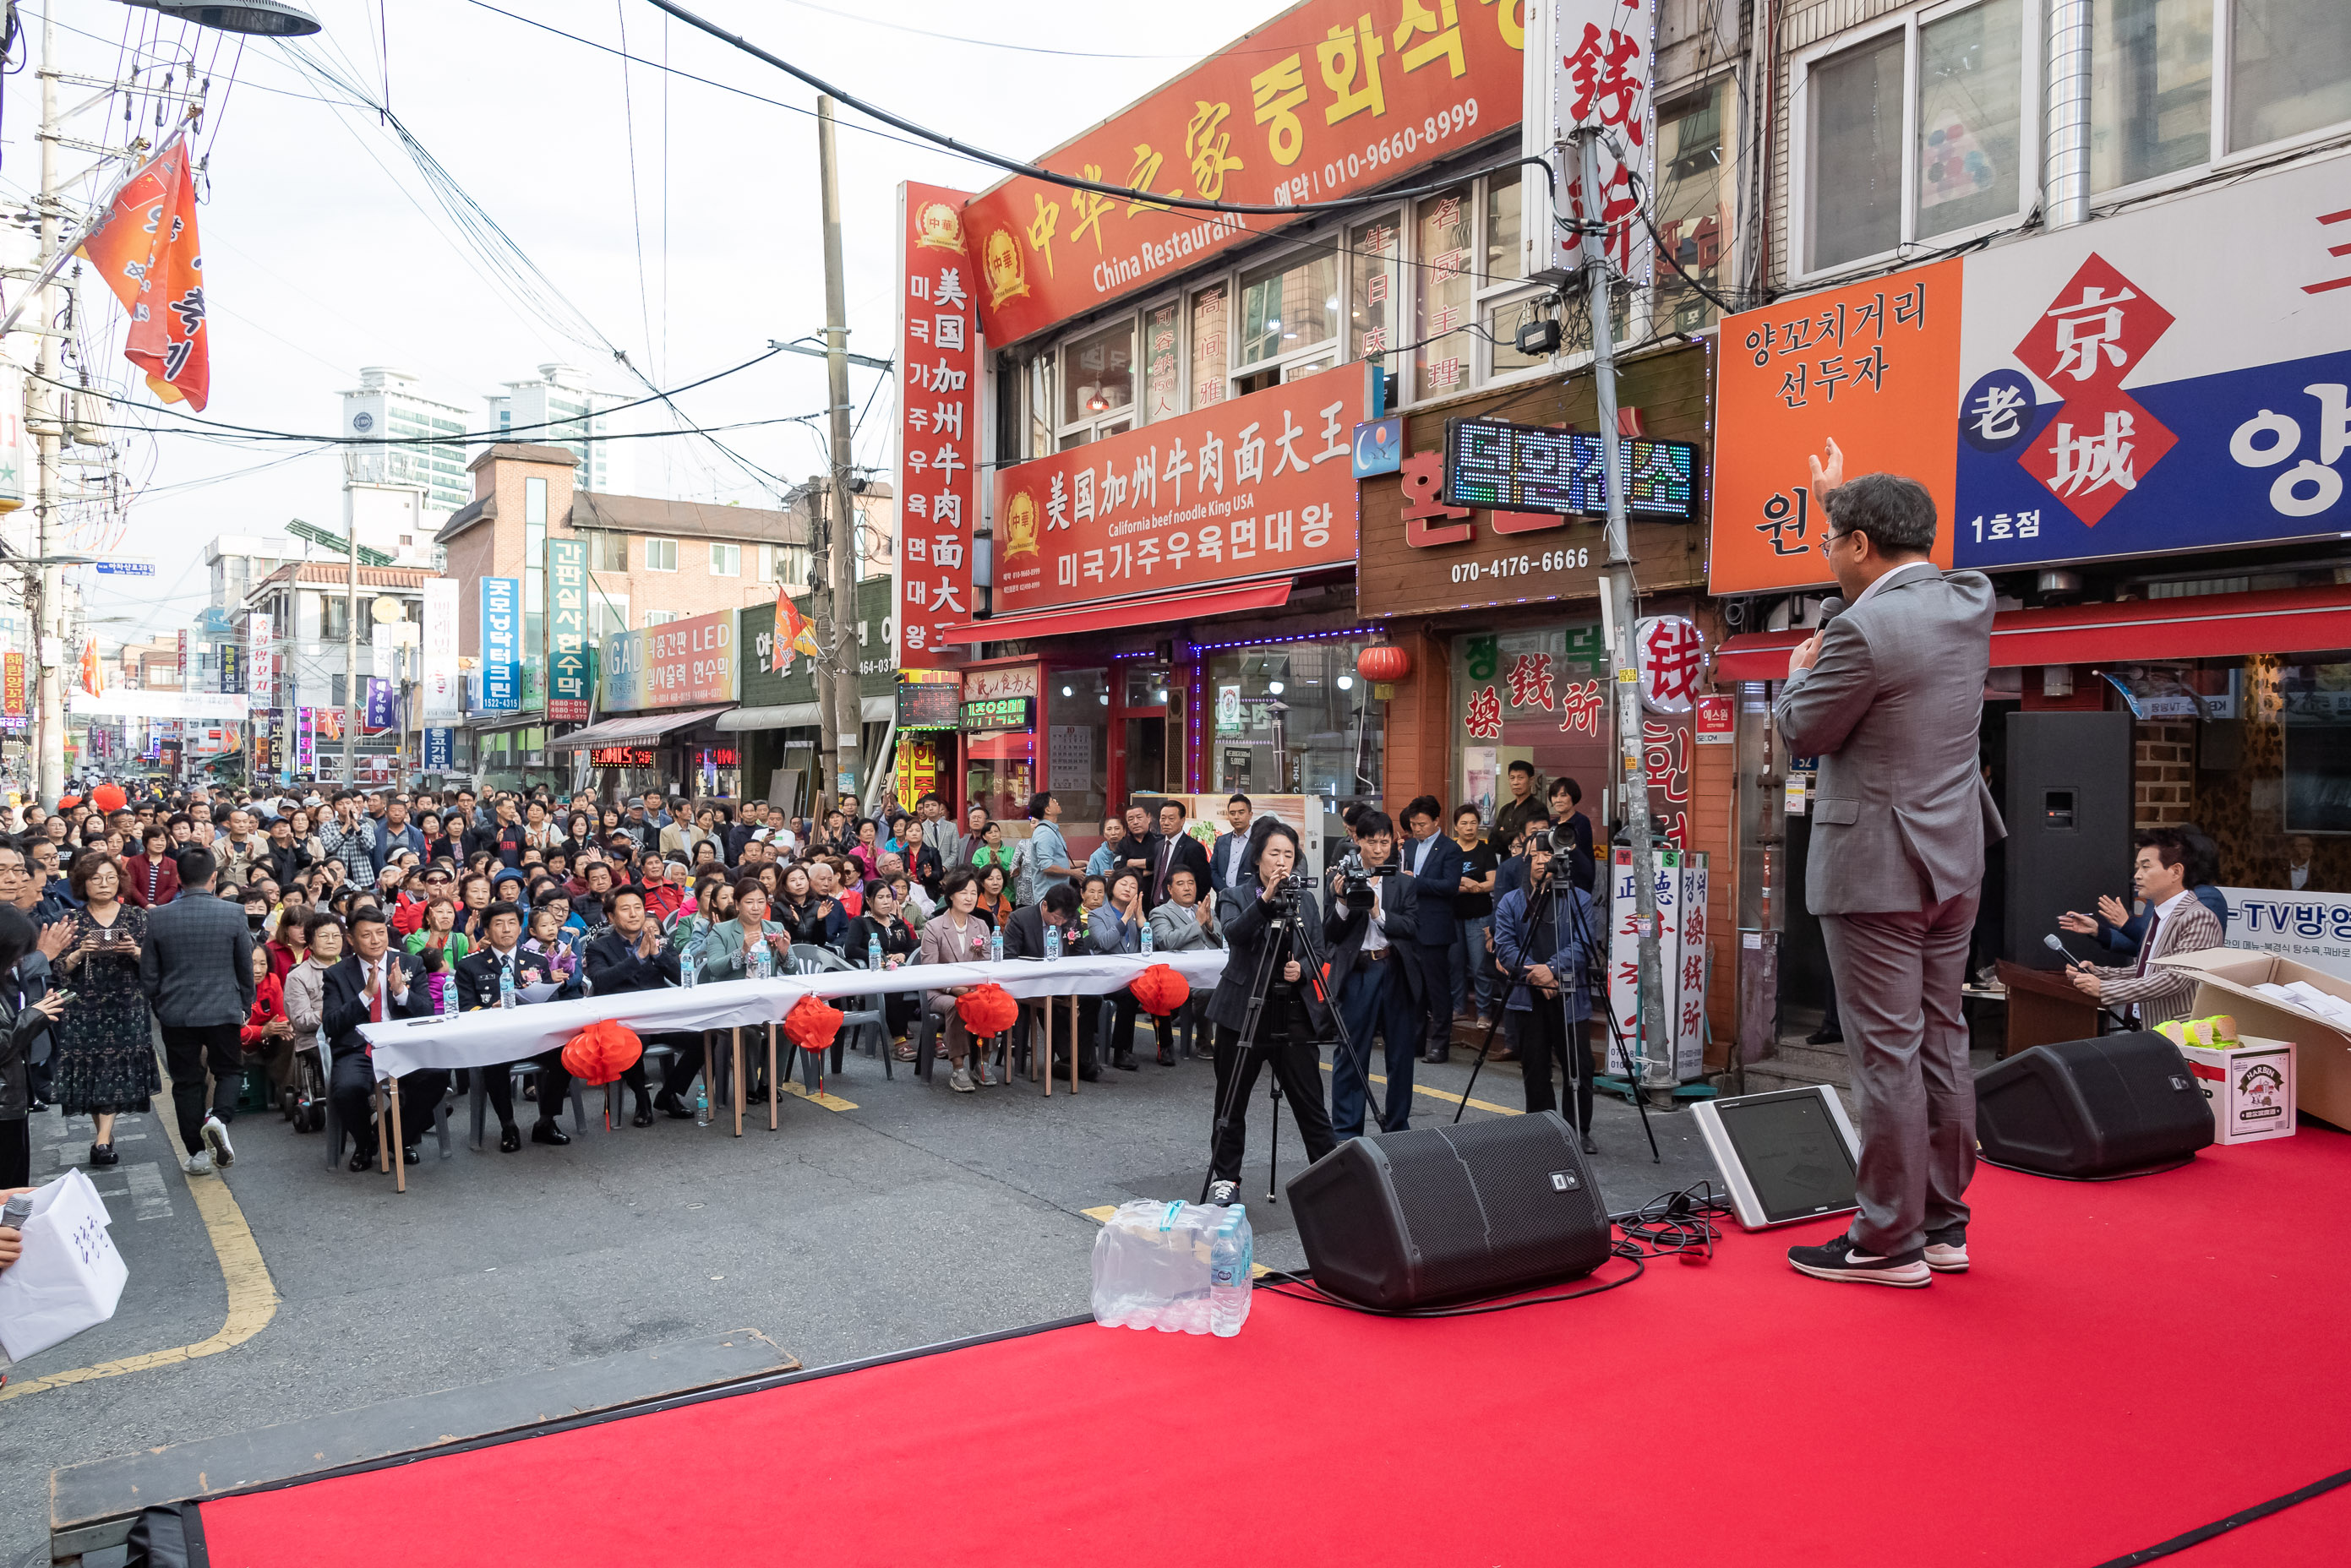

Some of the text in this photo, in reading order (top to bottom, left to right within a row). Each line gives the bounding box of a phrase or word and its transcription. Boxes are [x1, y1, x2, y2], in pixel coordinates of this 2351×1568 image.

[1323, 97, 1479, 188] 010-9660-8999
[929, 217, 953, 231] 中華
[993, 249, 1013, 273] 中華
[1094, 202, 1246, 292] China Restaurant
[1428, 196, 1462, 388] 名厨主理
[1745, 282, 1926, 368] 양꼬치거리
[1776, 346, 1890, 408] 선두자
[2046, 286, 2137, 498] 京城
[1970, 384, 2026, 440] 老
[905, 275, 930, 650] 미국가주우육면대왕
[1045, 400, 1351, 531] 美国加州牛肉面大王
[1012, 511, 1029, 530] 中華
[1108, 493, 1254, 538] California beef noodle King USA
[1972, 509, 2040, 543] 1호점
[1058, 503, 1333, 587] 미국가주우육면대왕
[1451, 547, 1589, 584] 070-4176-6666
[555, 542, 584, 698] 간판실사현수막
[646, 623, 730, 660] 각종간판 LED
[600, 636, 644, 677] KGAD
[646, 656, 729, 691] 실사출력 현수막
[1646, 619, 1701, 705] 钱
[484, 699, 518, 708] 1522-4315
[1703, 709, 1728, 721] 에스원
[430, 728, 446, 764] 중고가전
[2247, 1066, 2275, 1081] HARBIN
